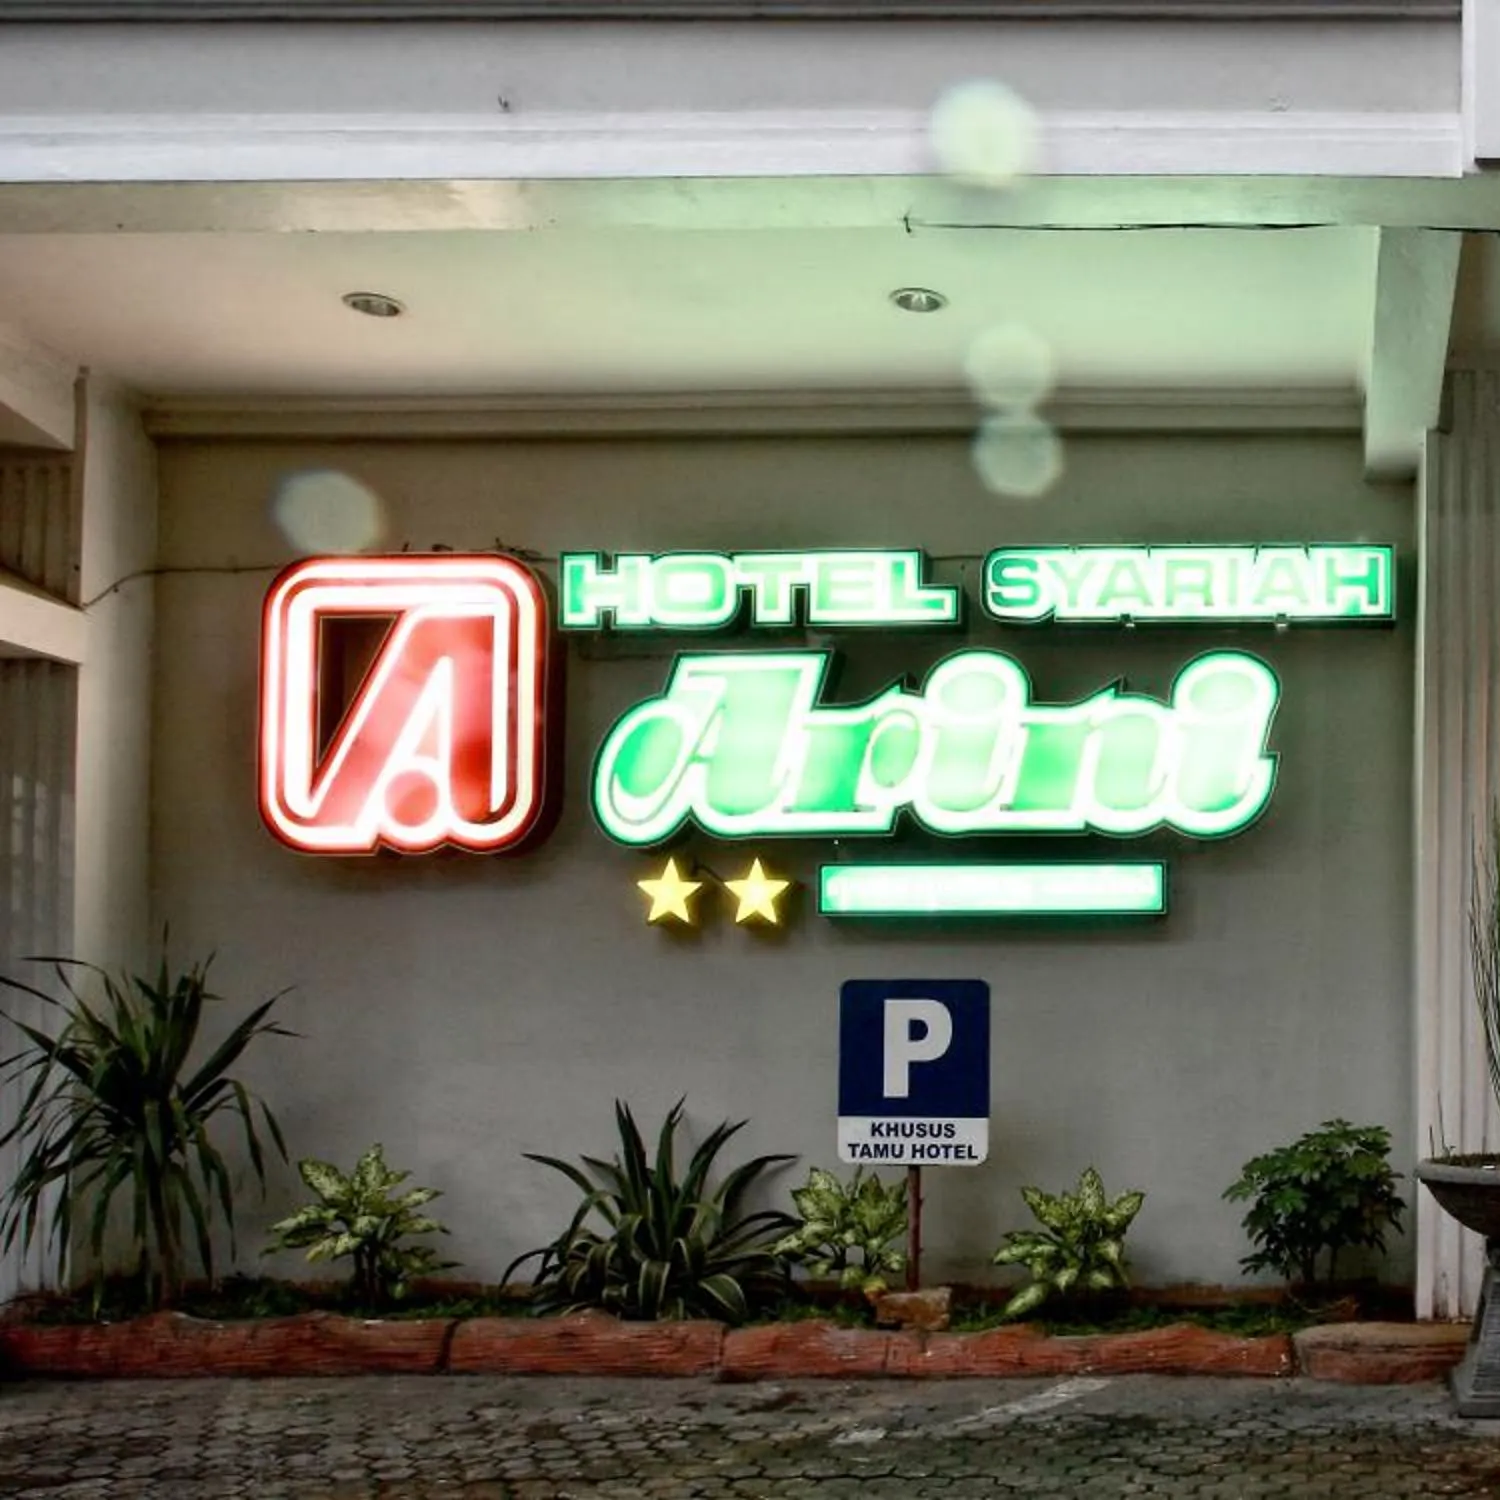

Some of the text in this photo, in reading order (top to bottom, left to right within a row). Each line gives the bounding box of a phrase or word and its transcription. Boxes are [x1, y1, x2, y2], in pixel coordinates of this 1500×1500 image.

[562, 551, 1388, 627] HOTEL SYARIAH
[599, 652, 1277, 840] Arini
[883, 999, 953, 1098] P
[847, 1142, 979, 1160] TAMU HOTEL
[870, 1122, 957, 1139] KHUSUS
